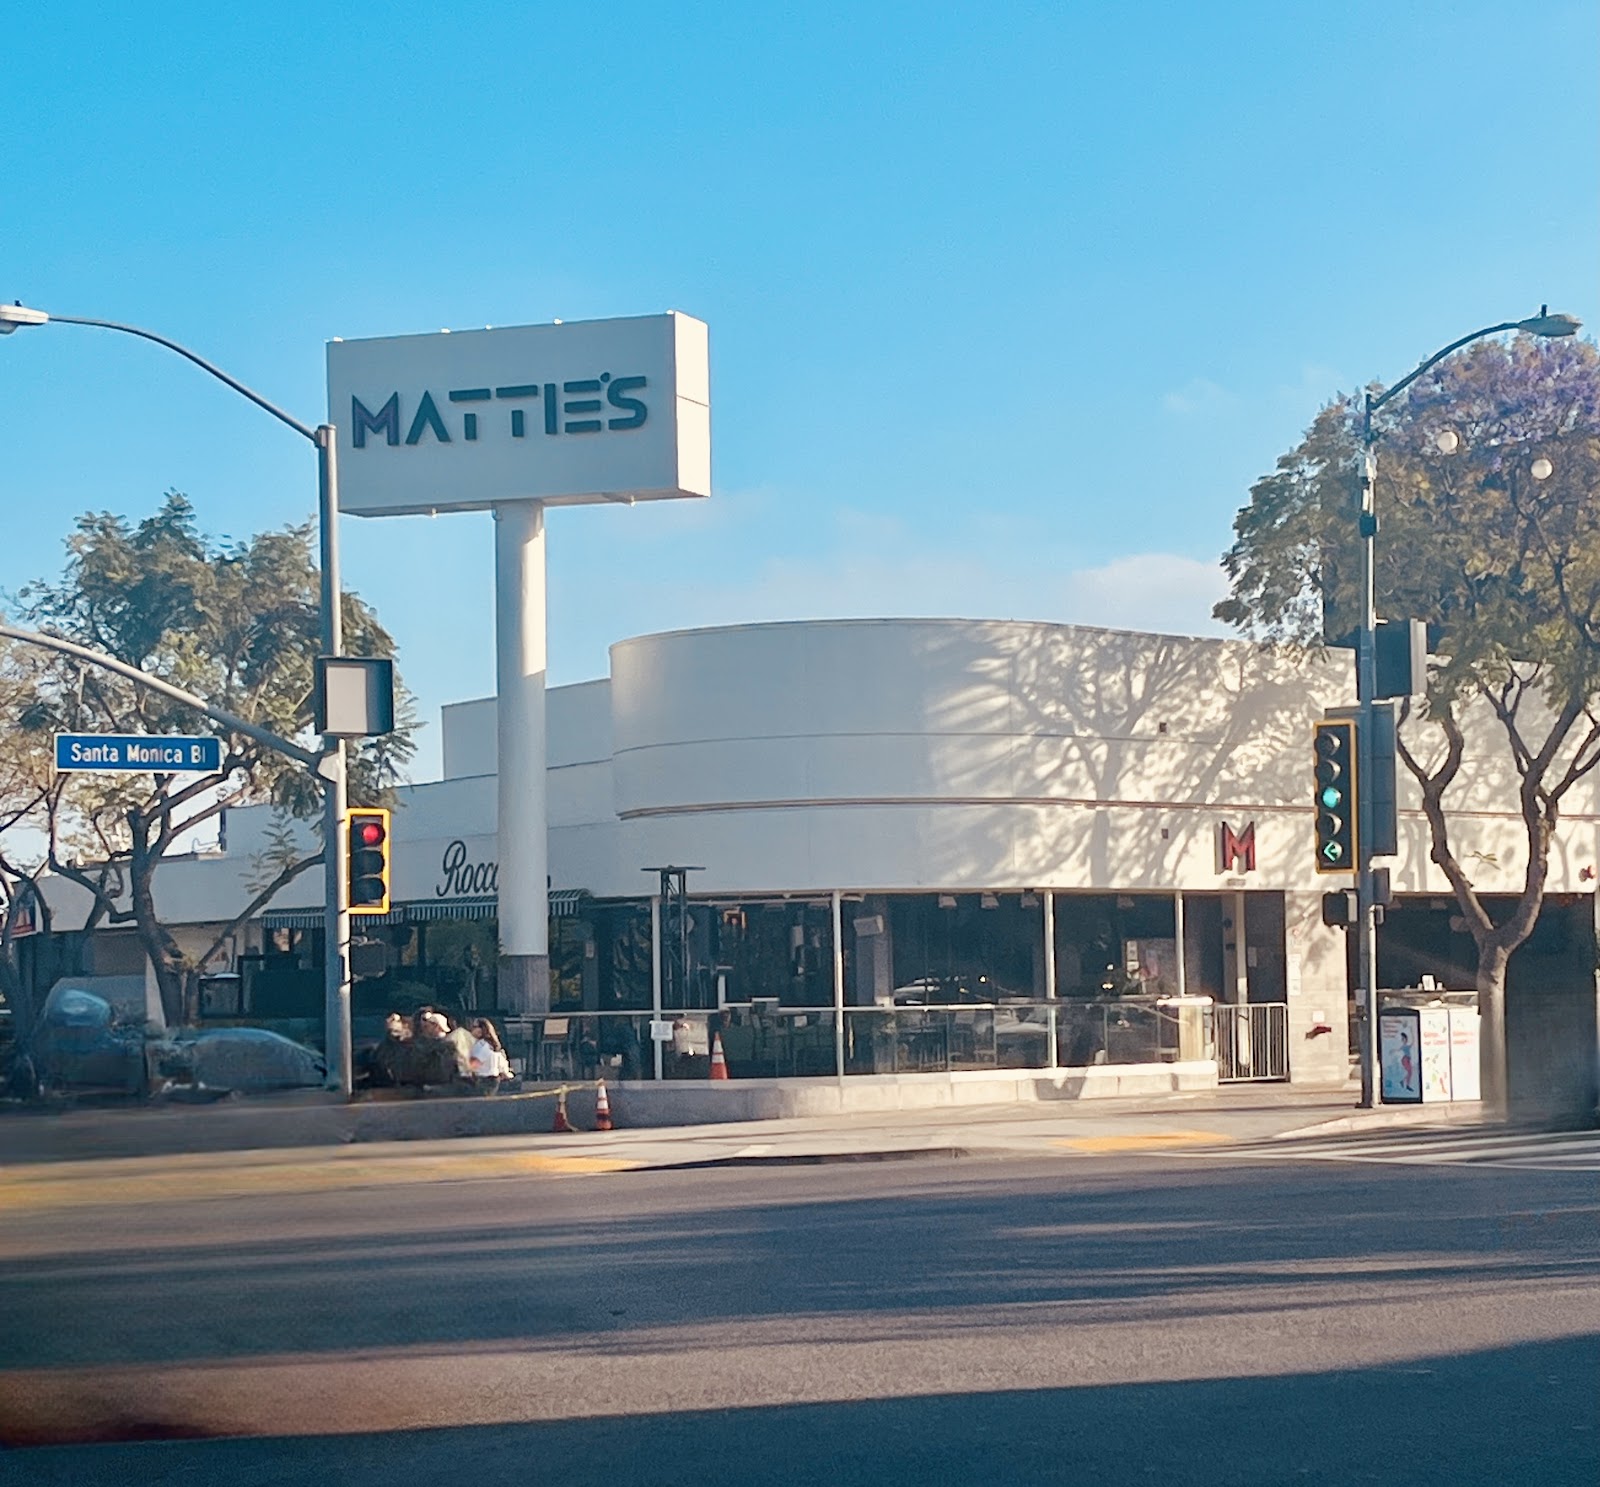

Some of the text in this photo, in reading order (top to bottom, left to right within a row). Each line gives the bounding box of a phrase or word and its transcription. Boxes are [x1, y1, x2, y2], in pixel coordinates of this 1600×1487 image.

[351, 372, 648, 449] MATTIE'S
[70, 743, 119, 763] Santa
[127, 744, 183, 763] Monica
[1220, 820, 1256, 871] M
